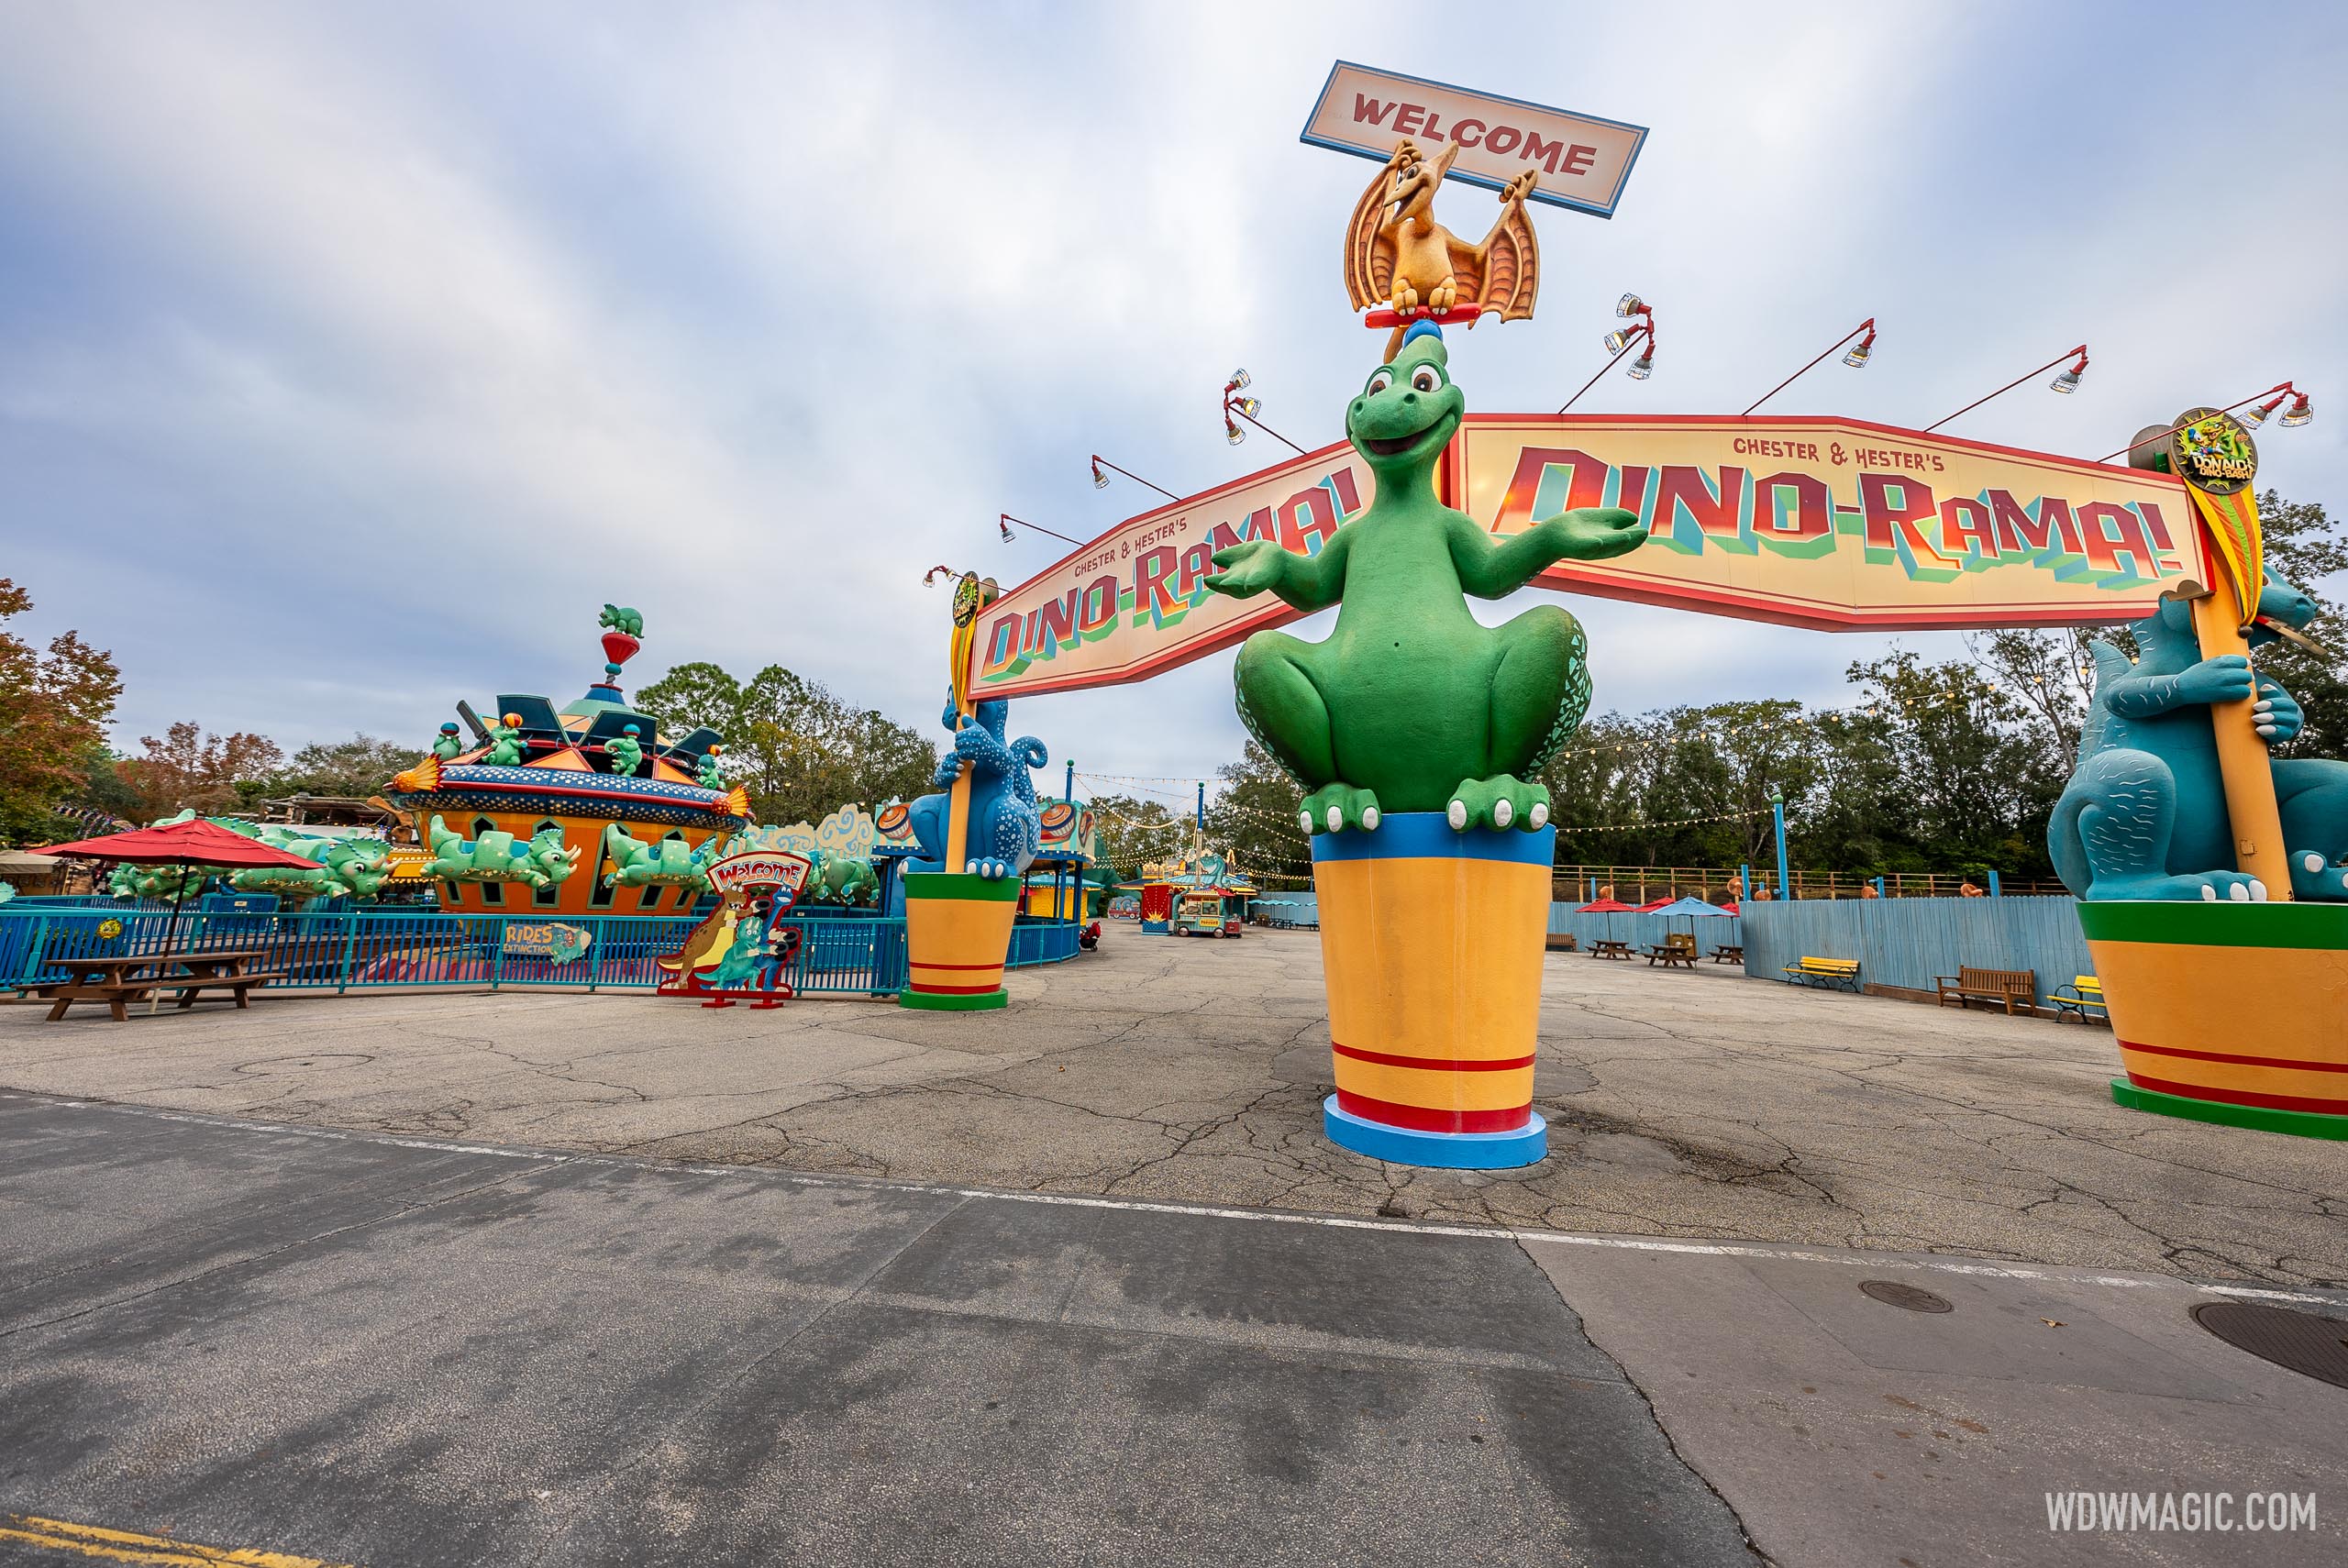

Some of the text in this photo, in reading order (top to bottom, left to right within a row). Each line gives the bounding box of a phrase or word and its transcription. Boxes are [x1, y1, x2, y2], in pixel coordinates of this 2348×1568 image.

[1353, 93, 1598, 176] WELCOME
[1733, 437, 1945, 472] CHESTER & HESTER'S
[1074, 517, 1188, 578] CHESTER & HESTER'S
[505, 925, 553, 944] RIDES
